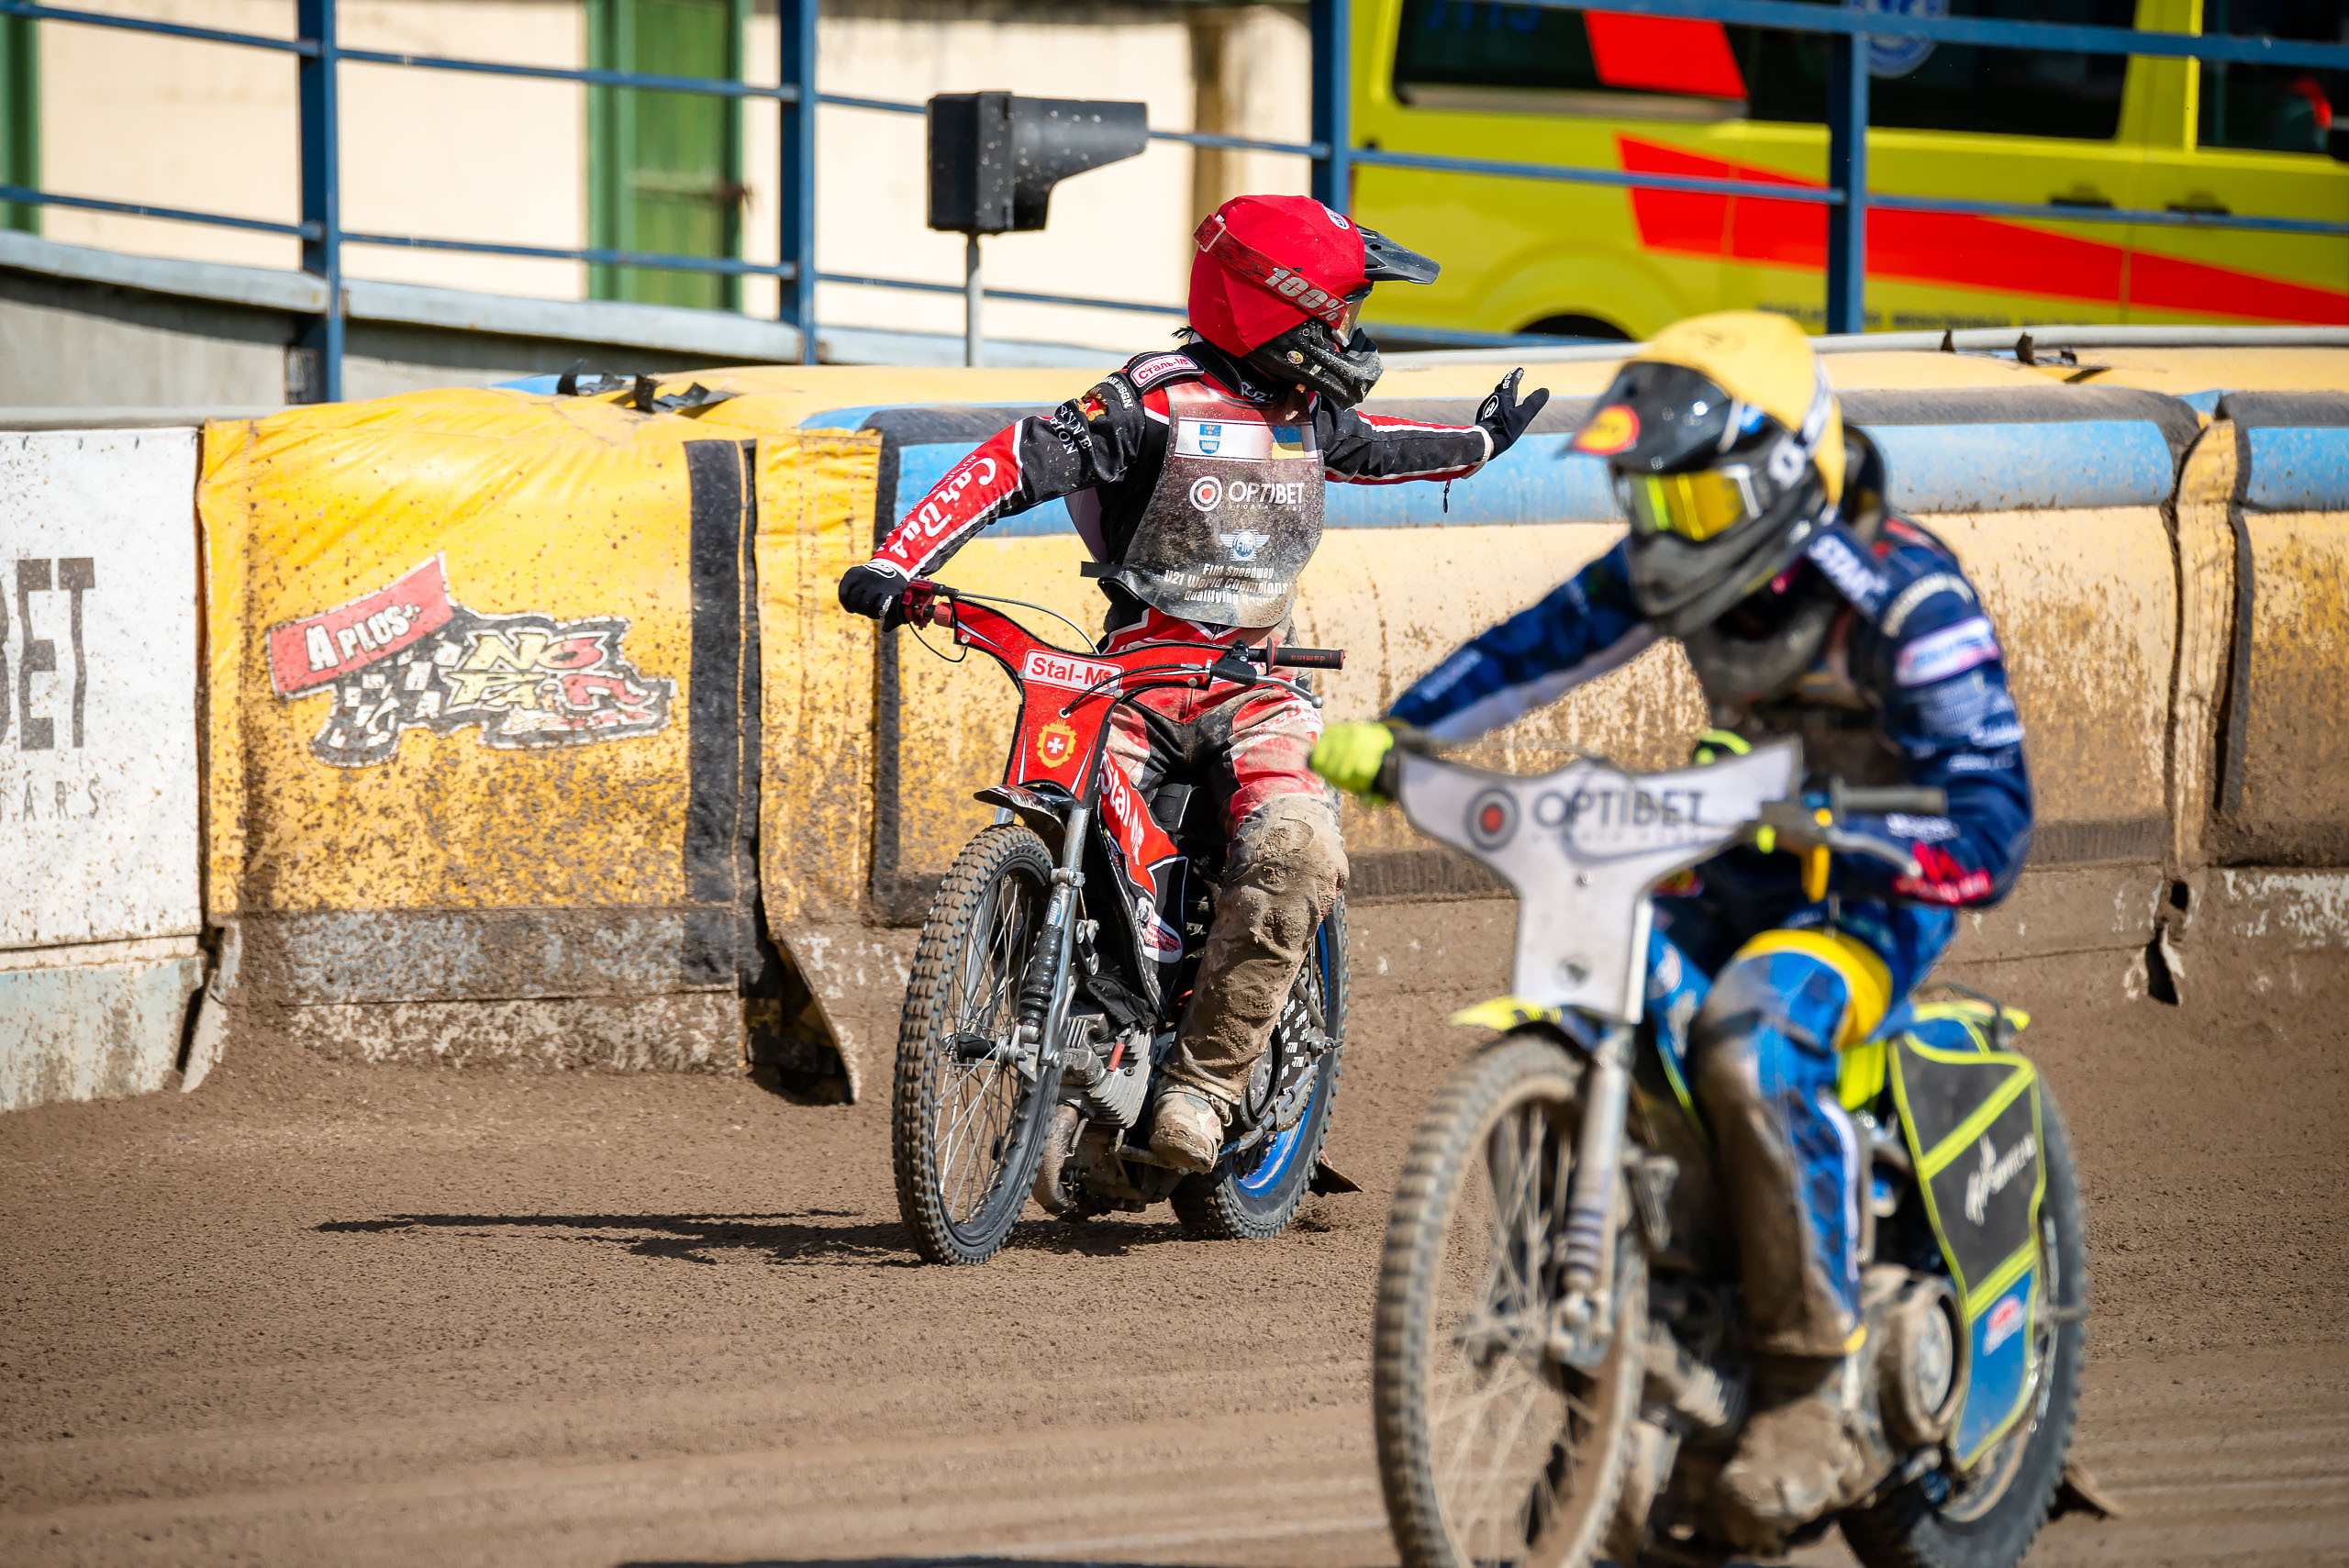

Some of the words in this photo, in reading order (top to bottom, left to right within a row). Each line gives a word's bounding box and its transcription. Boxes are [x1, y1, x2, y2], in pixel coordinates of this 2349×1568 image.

[1264, 267, 1345, 322] 100%
[1229, 481, 1305, 505] OPTIBET
[1164, 569, 1185, 585] U21
[1187, 574, 1225, 589] World
[1225, 578, 1293, 595] Champions
[1203, 562, 1224, 575] FIM
[1226, 565, 1275, 580] Speedway
[0, 556, 95, 751] ET
[305, 624, 340, 673] A
[1533, 789, 1706, 827] OPTIBET
